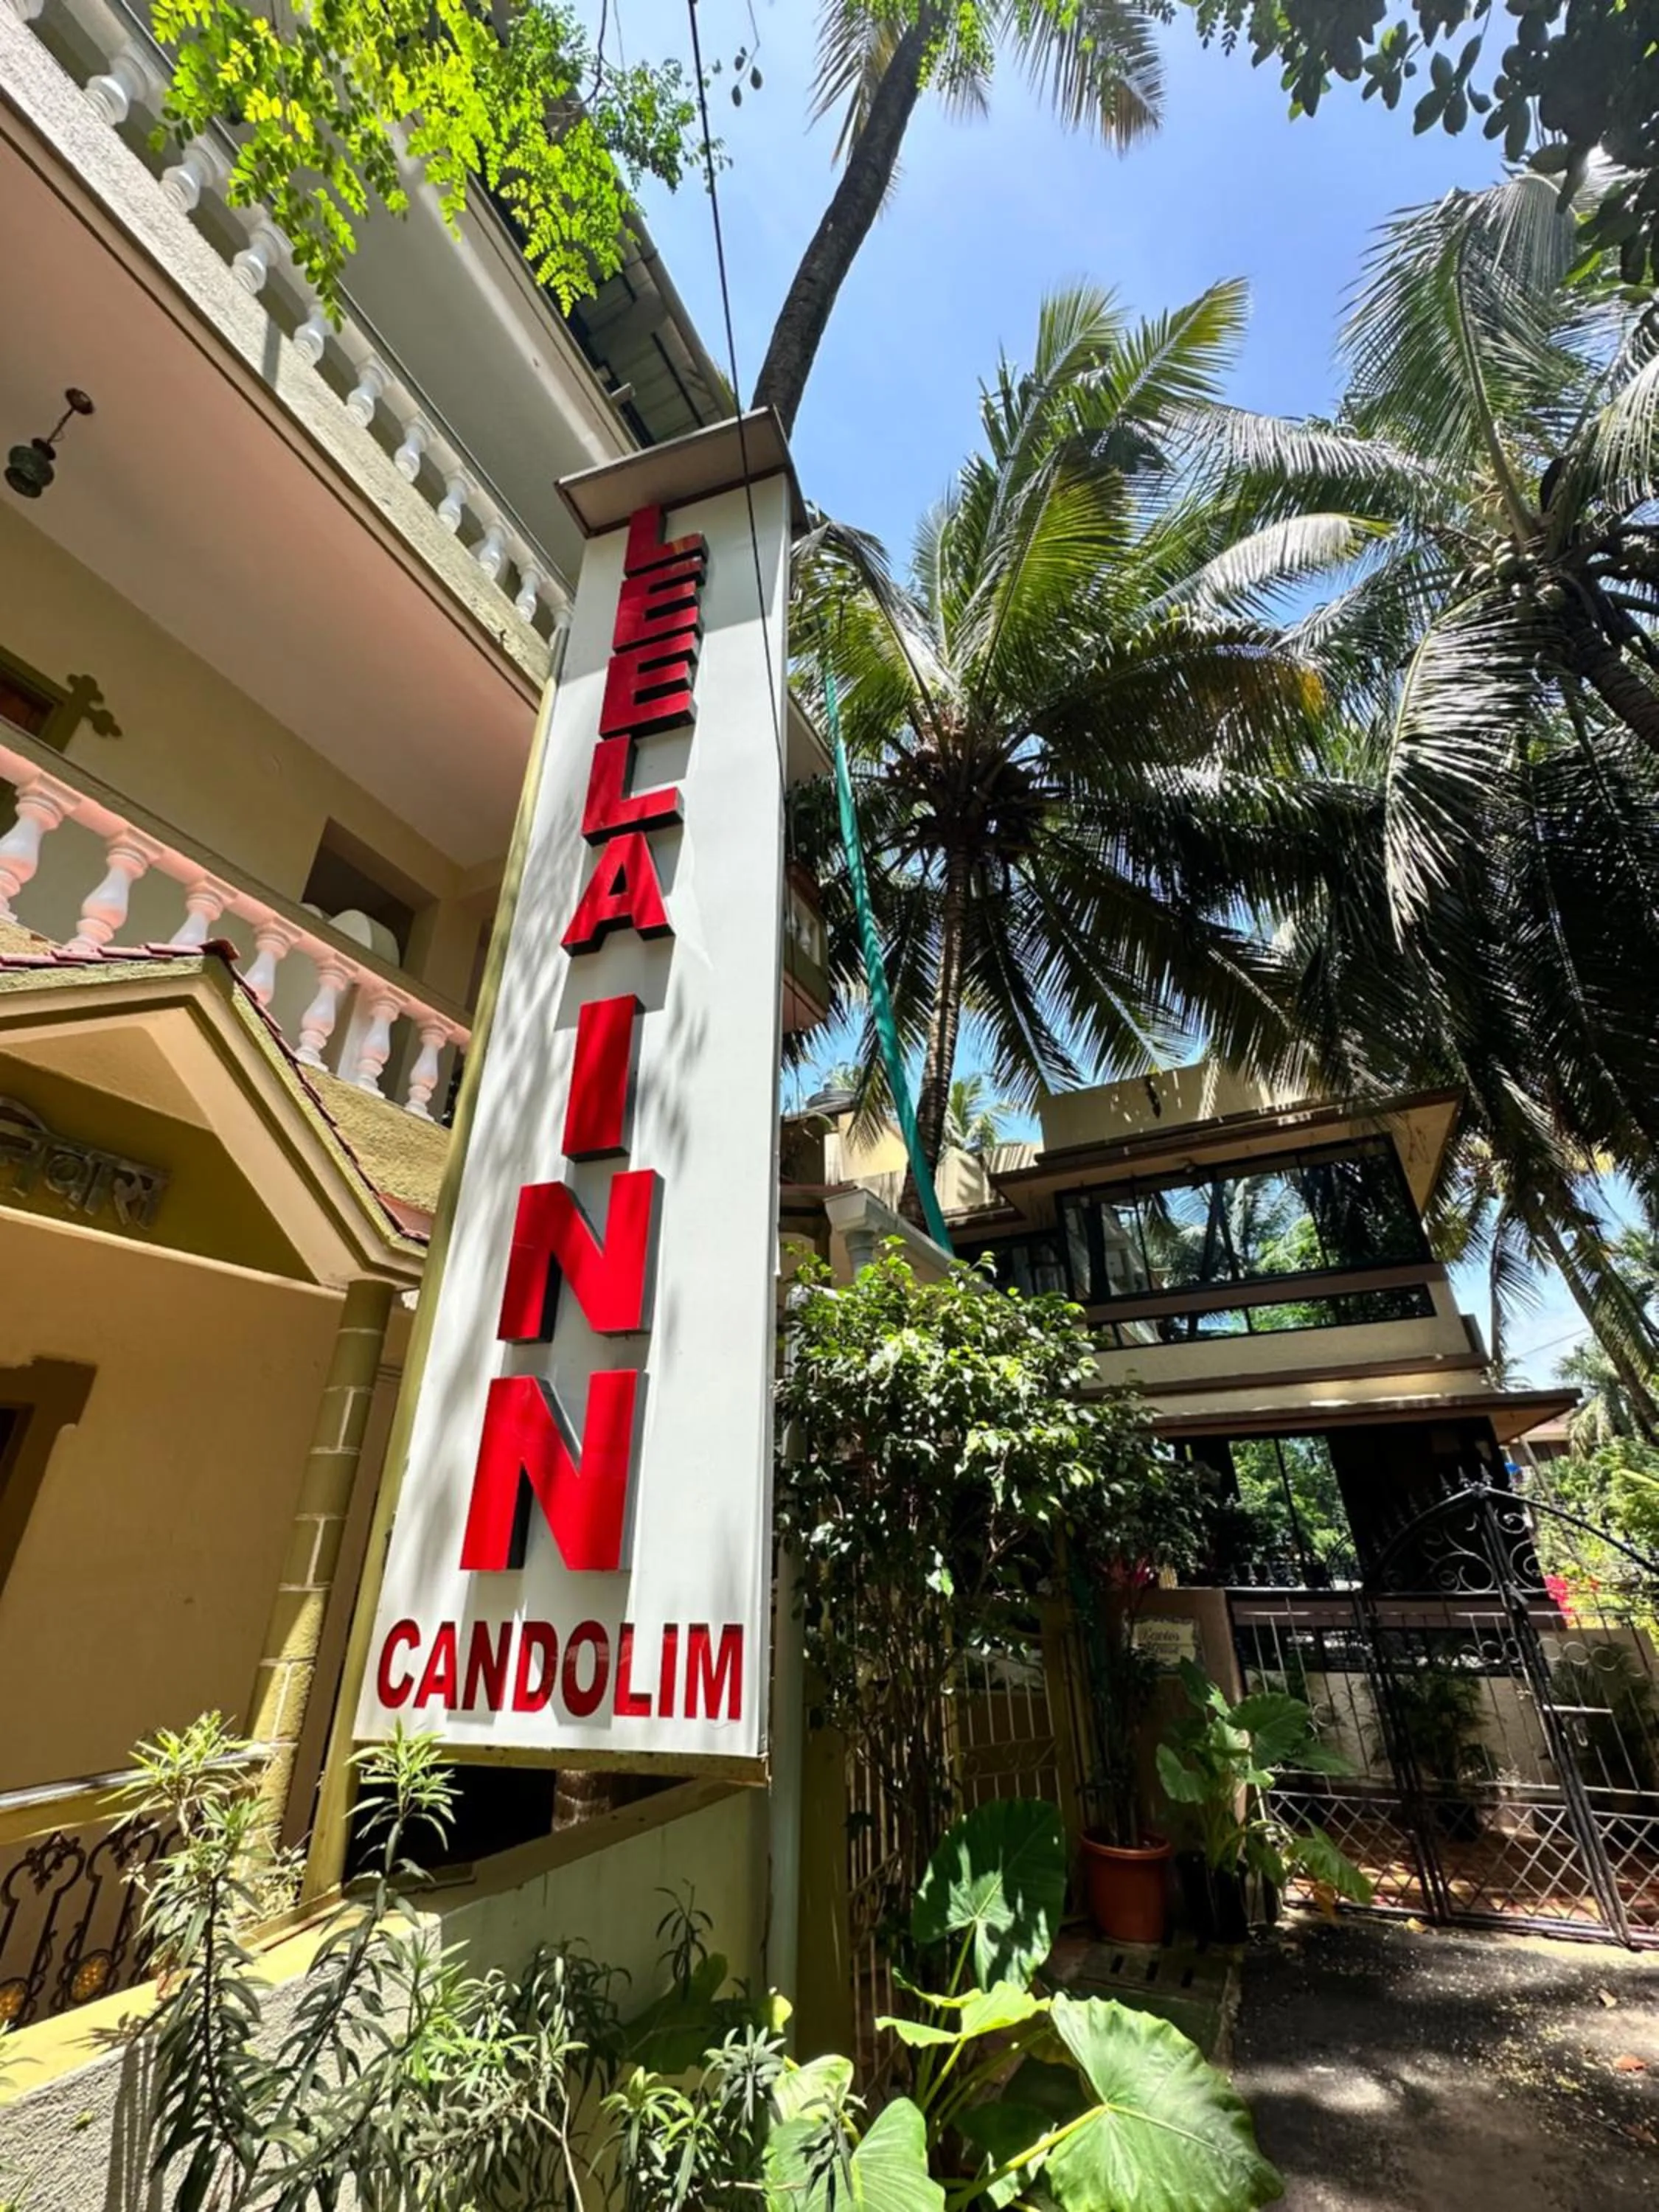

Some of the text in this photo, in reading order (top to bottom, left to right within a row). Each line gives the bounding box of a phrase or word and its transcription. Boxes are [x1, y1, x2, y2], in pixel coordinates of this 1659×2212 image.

[460, 504, 709, 1571] LEELA INN
[377, 1618, 744, 1721] CANDOLIM
